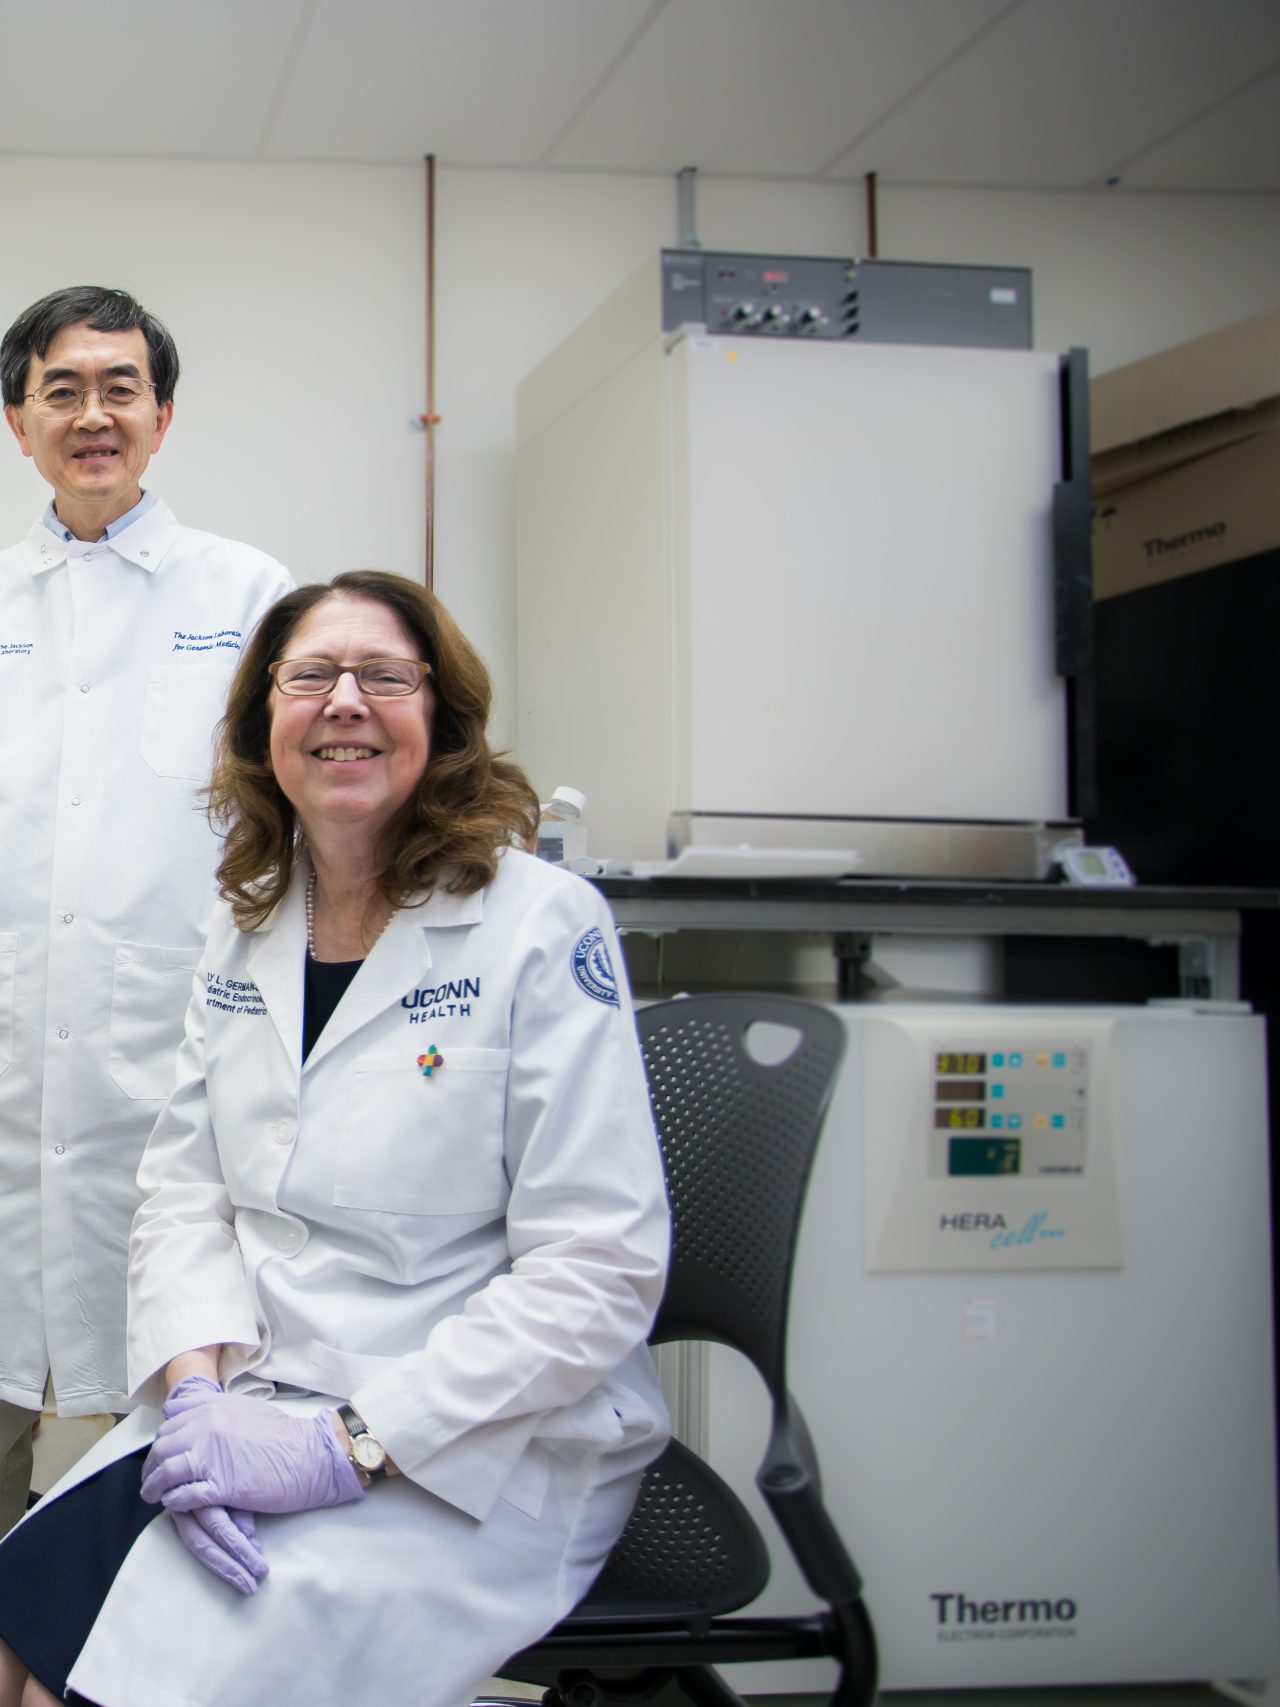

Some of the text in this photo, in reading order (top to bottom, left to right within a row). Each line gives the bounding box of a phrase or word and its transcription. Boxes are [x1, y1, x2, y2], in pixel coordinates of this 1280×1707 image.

[1144, 521, 1226, 558] Thermo
[173, 631, 186, 640] The
[187, 633, 213, 641] Jackson
[173, 643, 184, 651] for
[186, 643, 214, 651] Genomic
[215, 975, 223, 986] L.
[401, 977, 480, 1009] UCONN
[236, 1006, 244, 1014] of
[409, 1003, 471, 1024] HEALTH
[940, 1212, 1006, 1230] HERA
[930, 1592, 1077, 1624] Thermo
[937, 1627, 1077, 1642] ELECTRON CORPORATION
